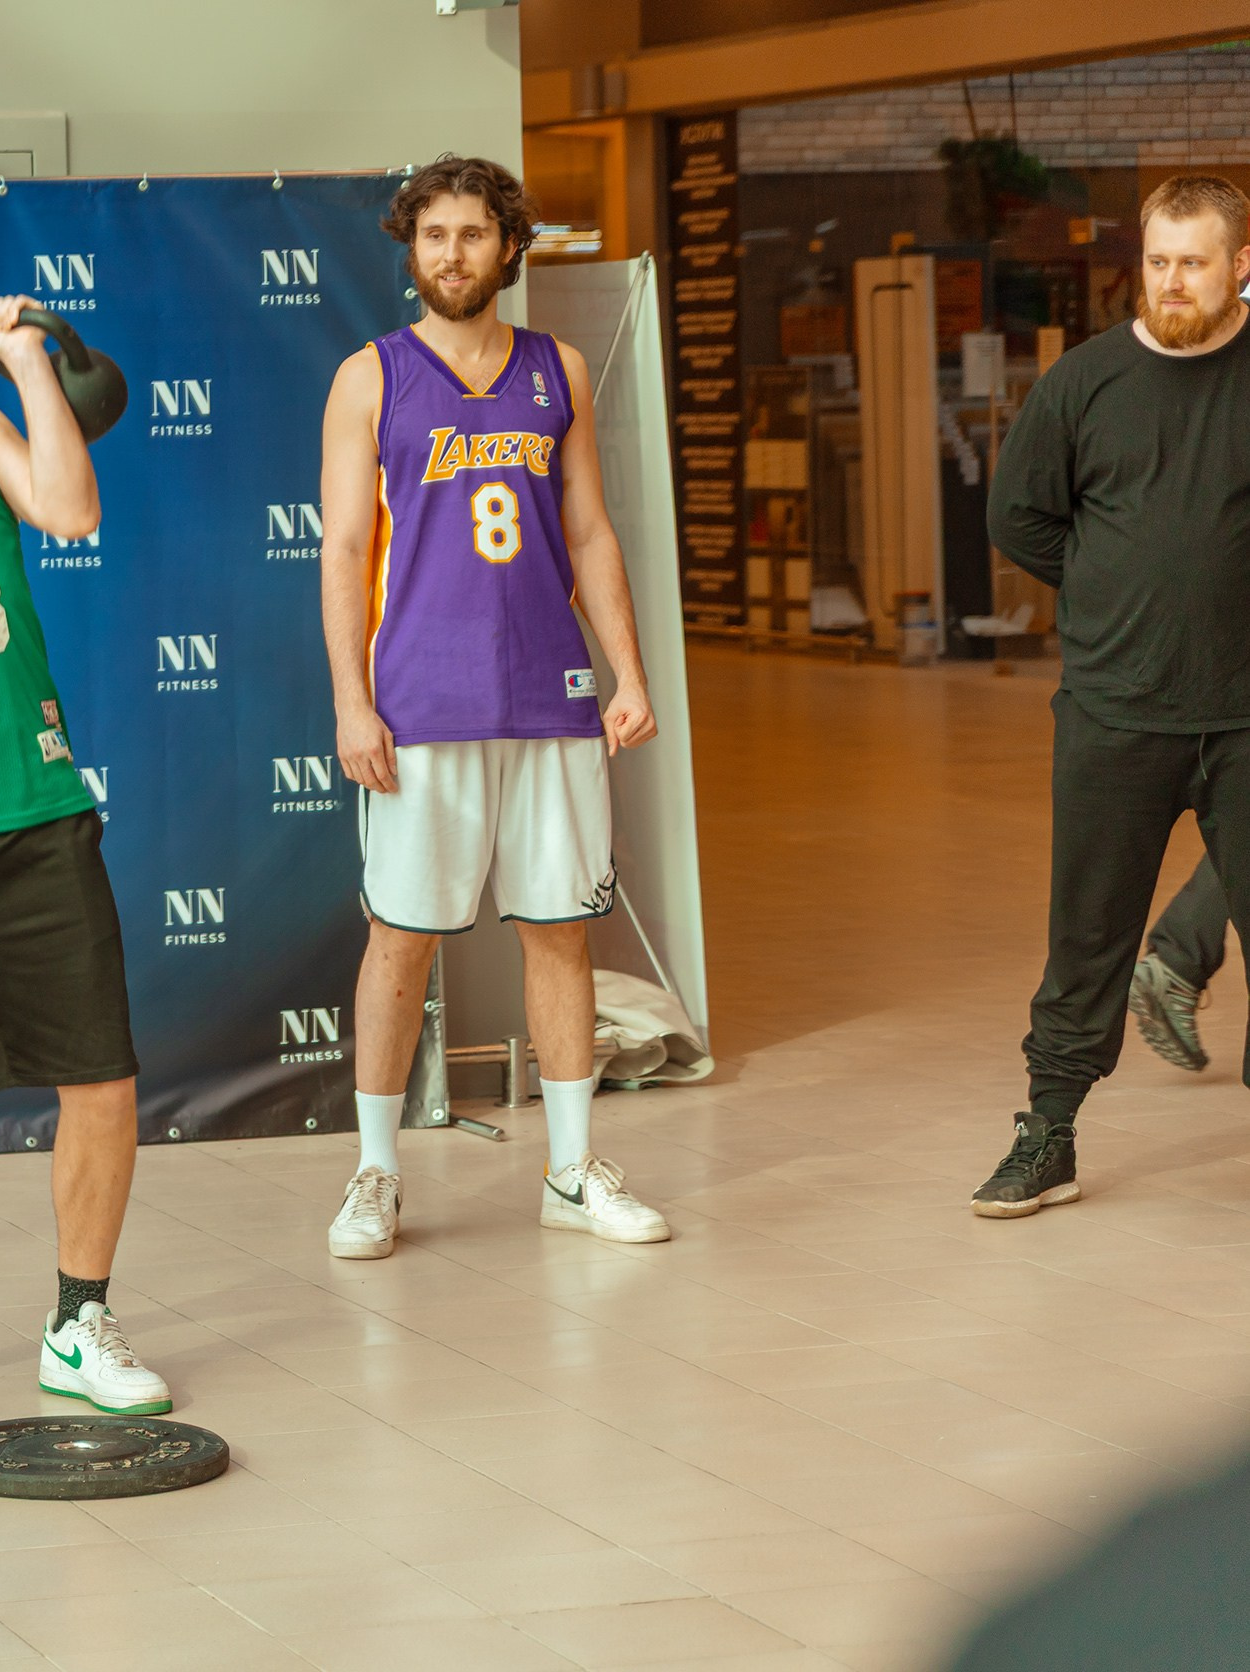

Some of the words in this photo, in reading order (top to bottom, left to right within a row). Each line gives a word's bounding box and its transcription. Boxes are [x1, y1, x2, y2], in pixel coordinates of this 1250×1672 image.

[33, 254, 95, 291] NN
[260, 249, 320, 286] NN
[40, 300, 96, 311] ITNESS
[261, 294, 320, 306] FITNESS
[151, 379, 212, 417] NN
[151, 424, 213, 436] FITNESS
[420, 426, 556, 486] LAKERS
[266, 503, 323, 540] NN
[470, 481, 522, 564] 8
[41, 556, 102, 569] FITNESS
[157, 634, 218, 671] NN
[158, 679, 219, 691] FITNESS
[272, 755, 333, 793] NN
[273, 800, 334, 813] FITNESS
[164, 888, 225, 926] NN
[165, 932, 227, 945] FITNESS
[280, 1006, 341, 1045] NN
[280, 1050, 343, 1064] FITNESS
